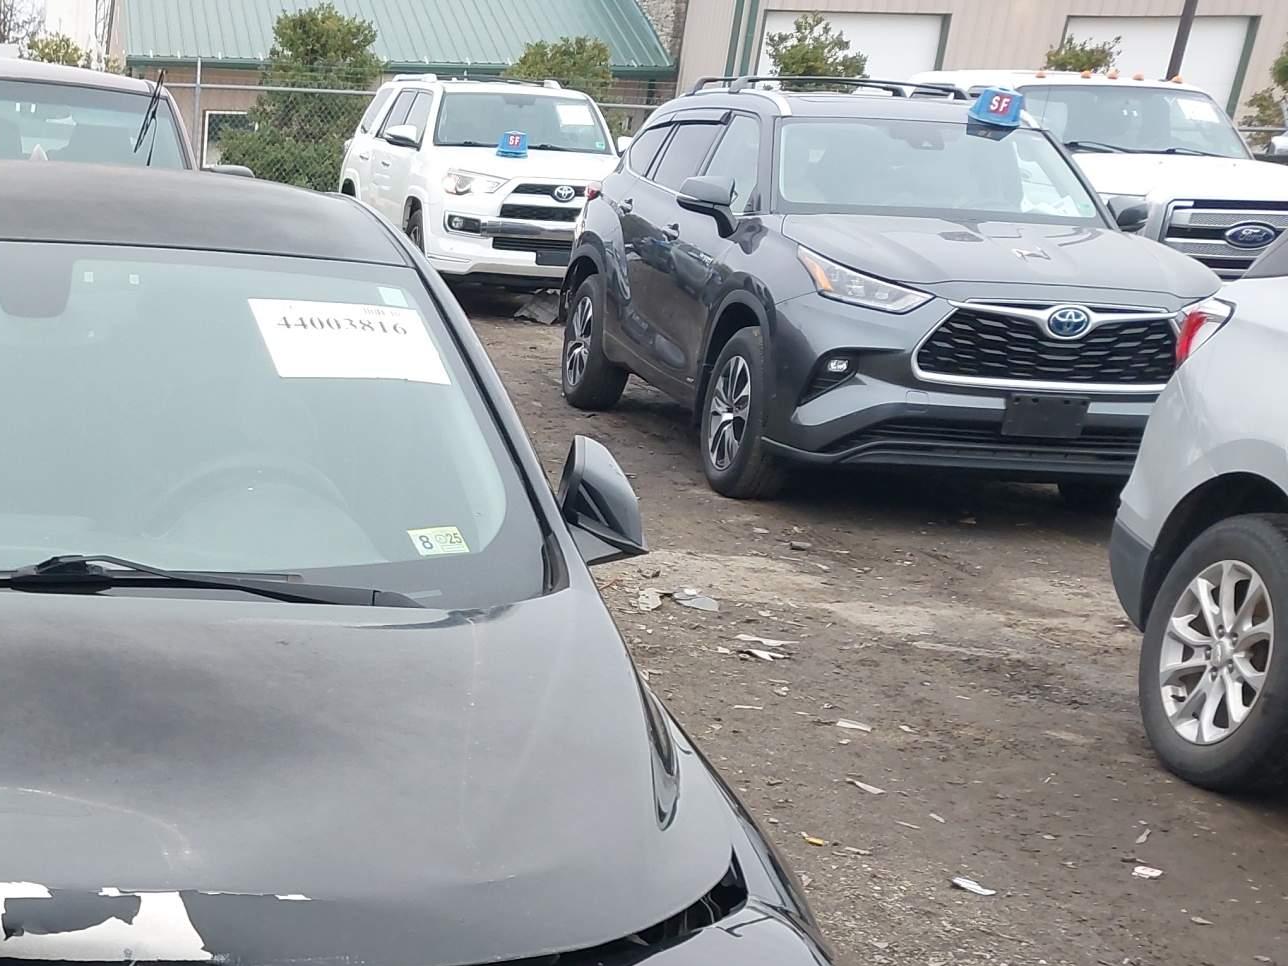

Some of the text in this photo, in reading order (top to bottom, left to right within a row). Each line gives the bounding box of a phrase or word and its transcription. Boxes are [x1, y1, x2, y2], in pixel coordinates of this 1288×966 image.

[989, 95, 1011, 112] SF
[508, 135, 520, 145] SF
[1239, 228, 1268, 241] Ford
[276, 315, 409, 336] 44003816
[418, 532, 463, 550] 8 25
